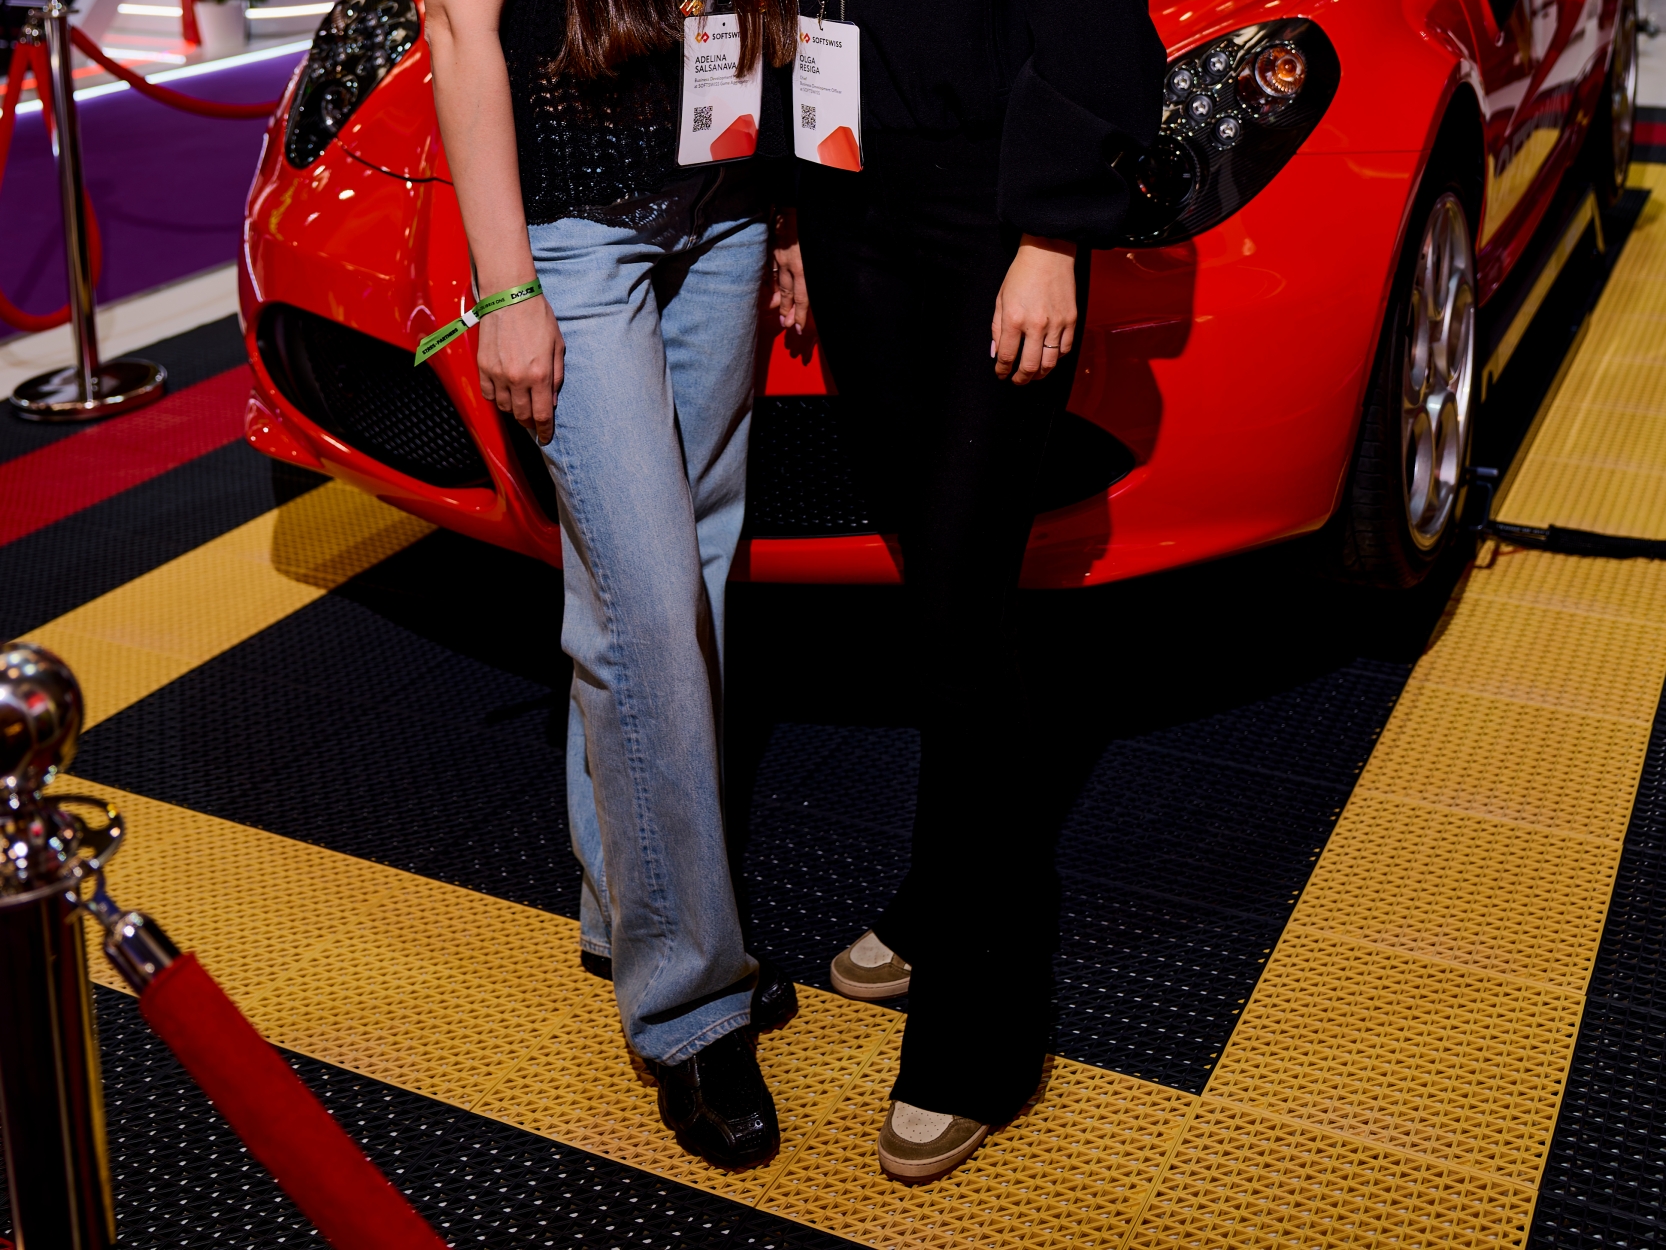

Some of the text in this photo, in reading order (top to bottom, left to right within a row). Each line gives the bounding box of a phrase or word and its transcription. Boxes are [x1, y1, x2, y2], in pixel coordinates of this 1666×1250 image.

[712, 31, 740, 40] SOFTSWI
[812, 36, 842, 48] SOFTSWISS
[694, 54, 727, 65] ADELINA
[800, 54, 816, 65] OLGA
[694, 62, 737, 74] SALSANAVA
[800, 63, 821, 75] RESIGA
